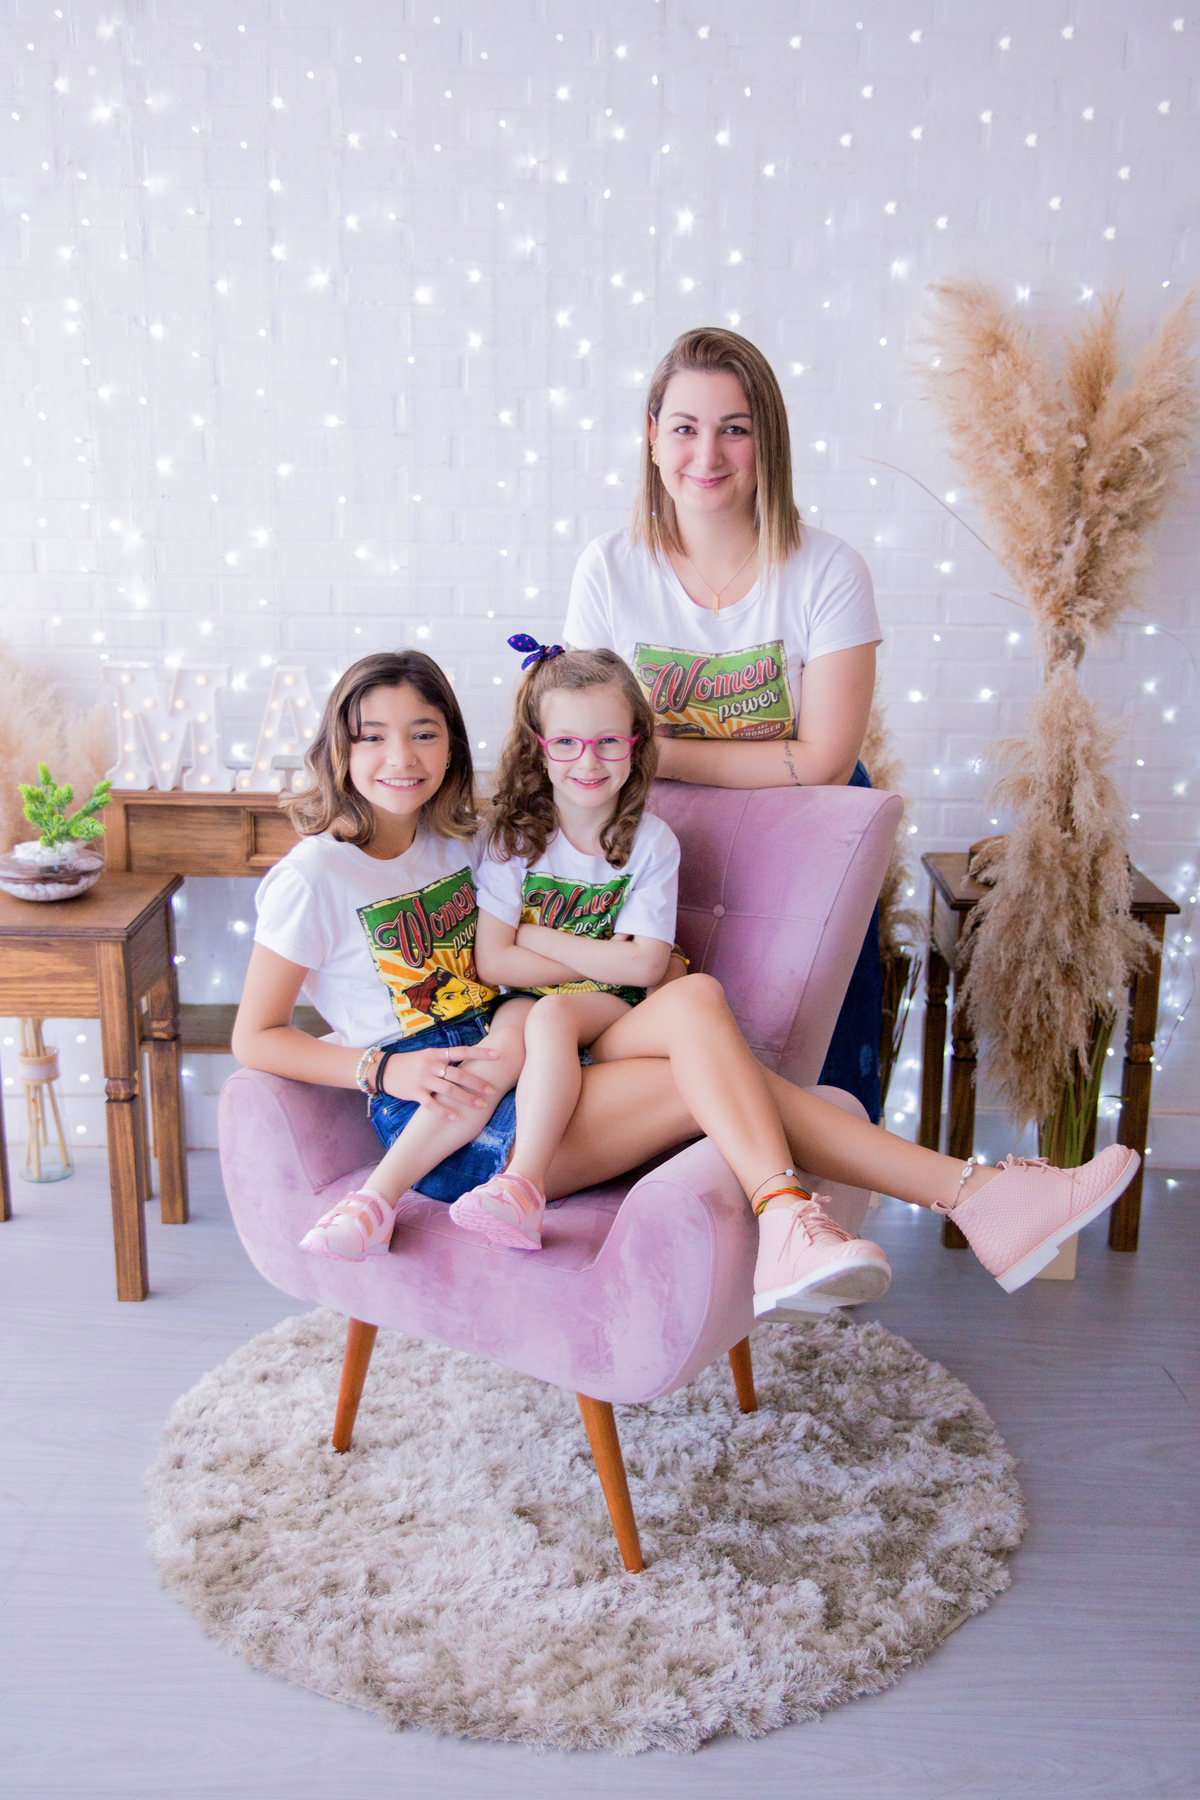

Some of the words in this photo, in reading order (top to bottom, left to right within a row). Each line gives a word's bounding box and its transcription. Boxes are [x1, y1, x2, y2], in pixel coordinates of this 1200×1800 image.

[638, 656, 780, 713] Women
[718, 688, 779, 723] power
[733, 722, 781, 738] STRONGER
